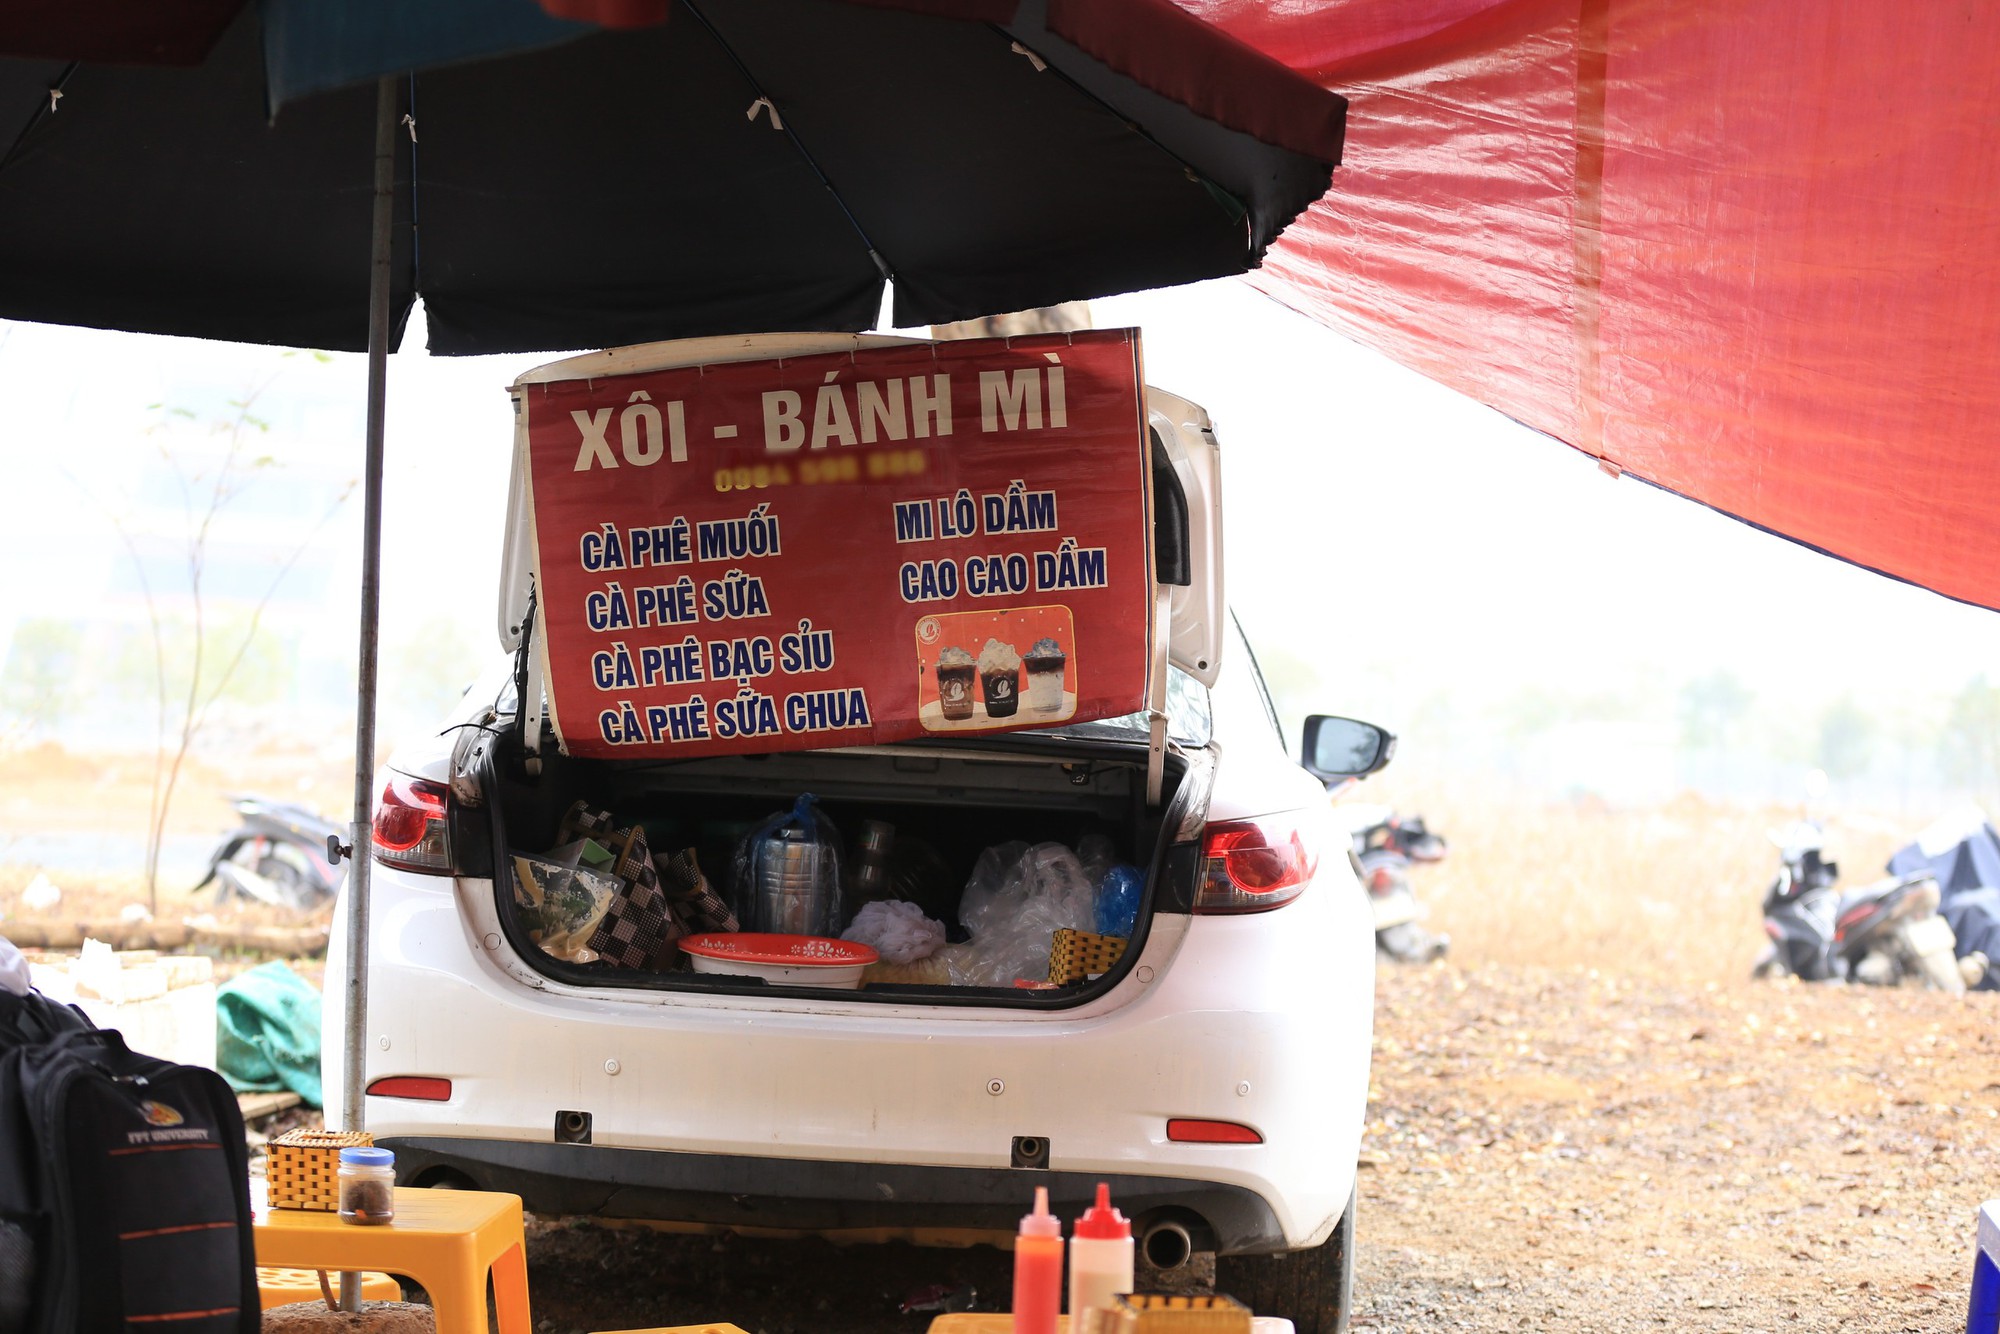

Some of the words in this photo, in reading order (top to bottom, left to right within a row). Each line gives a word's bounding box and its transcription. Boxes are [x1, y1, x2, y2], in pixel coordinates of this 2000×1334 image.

[569, 390, 688, 472] XÔI
[762, 371, 952, 450] BÁNH
[979, 352, 1067, 432] MÌ
[580, 522, 627, 572] CÀ
[629, 516, 693, 568] PHÊ
[696, 502, 781, 562] MUỐI
[893, 499, 934, 543] MI
[937, 488, 977, 539] LÔ
[982, 479, 1058, 536] DẦM
[585, 581, 633, 632] CÀ
[634, 574, 699, 628] PHÊ
[703, 568, 771, 622] SỮA
[900, 560, 959, 603] CAO
[964, 553, 1029, 597] CAO
[1034, 537, 1108, 592] DẦM
[591, 641, 639, 691] CÀ
[640, 635, 705, 687] PHÊ
[707, 636, 774, 687] BẠC
[779, 617, 834, 674] SỈU
[599, 700, 647, 746] CÀ
[646, 694, 712, 743] PHÊ
[715, 687, 782, 739] SỮA
[784, 687, 872, 734] CHUA
